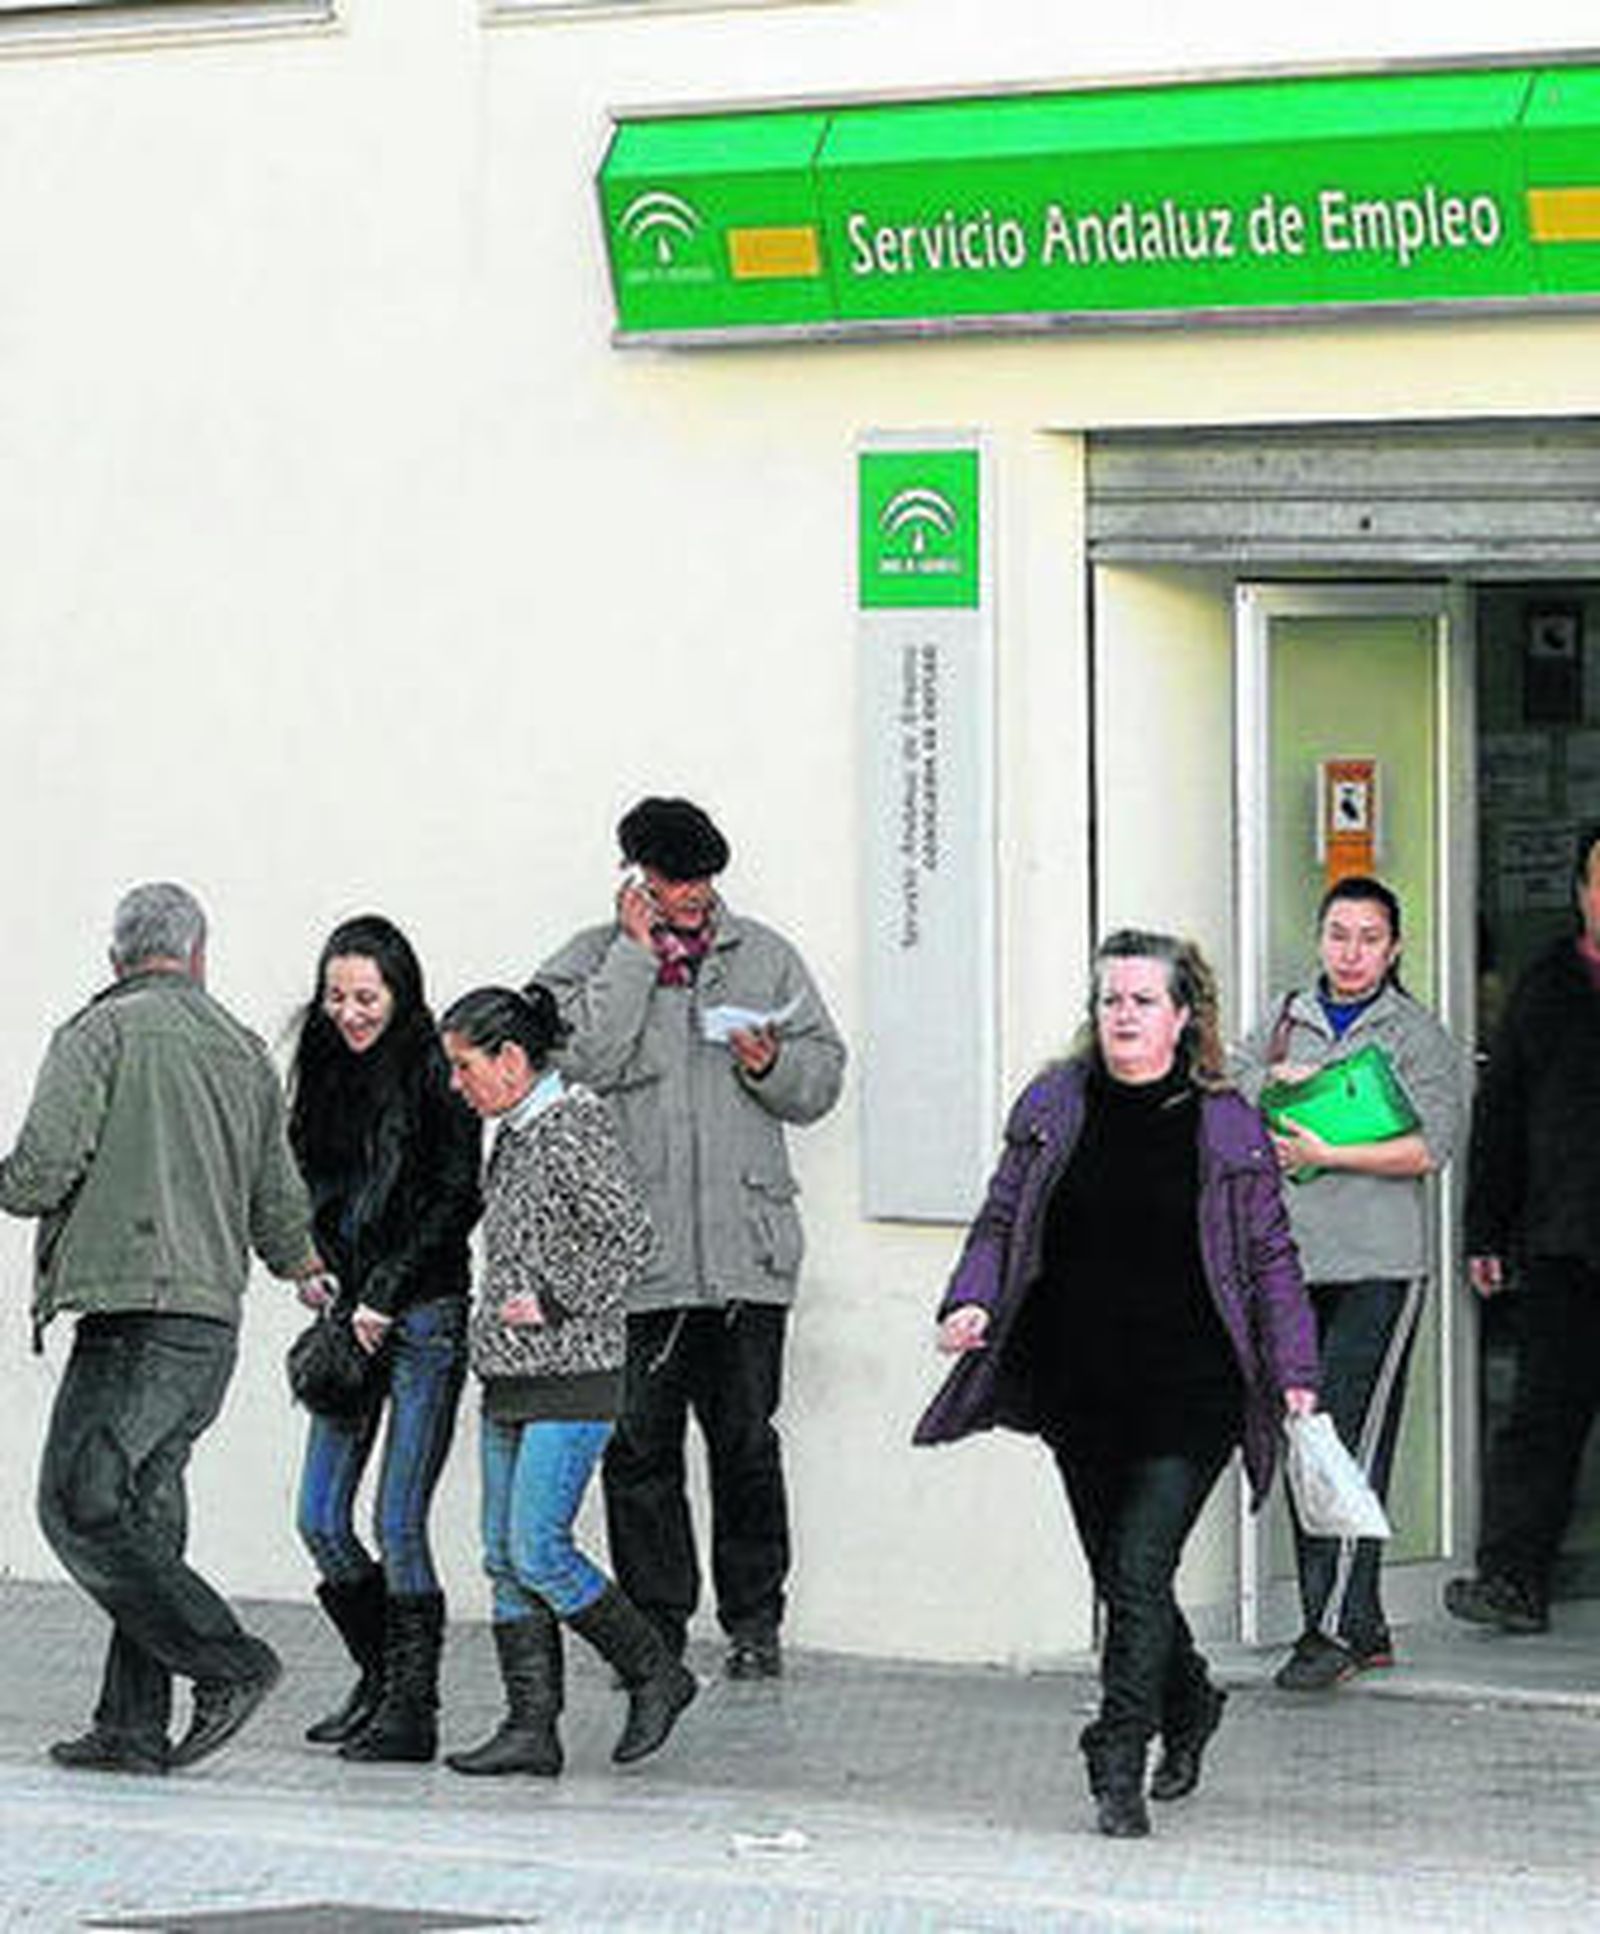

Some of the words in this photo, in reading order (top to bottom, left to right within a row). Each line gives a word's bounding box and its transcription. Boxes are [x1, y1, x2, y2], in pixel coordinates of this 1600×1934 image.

[848, 210, 1026, 274] Servicio
[1043, 199, 1236, 265] Andaluz
[1250, 194, 1304, 254] de
[1319, 185, 1500, 267] Empleo
